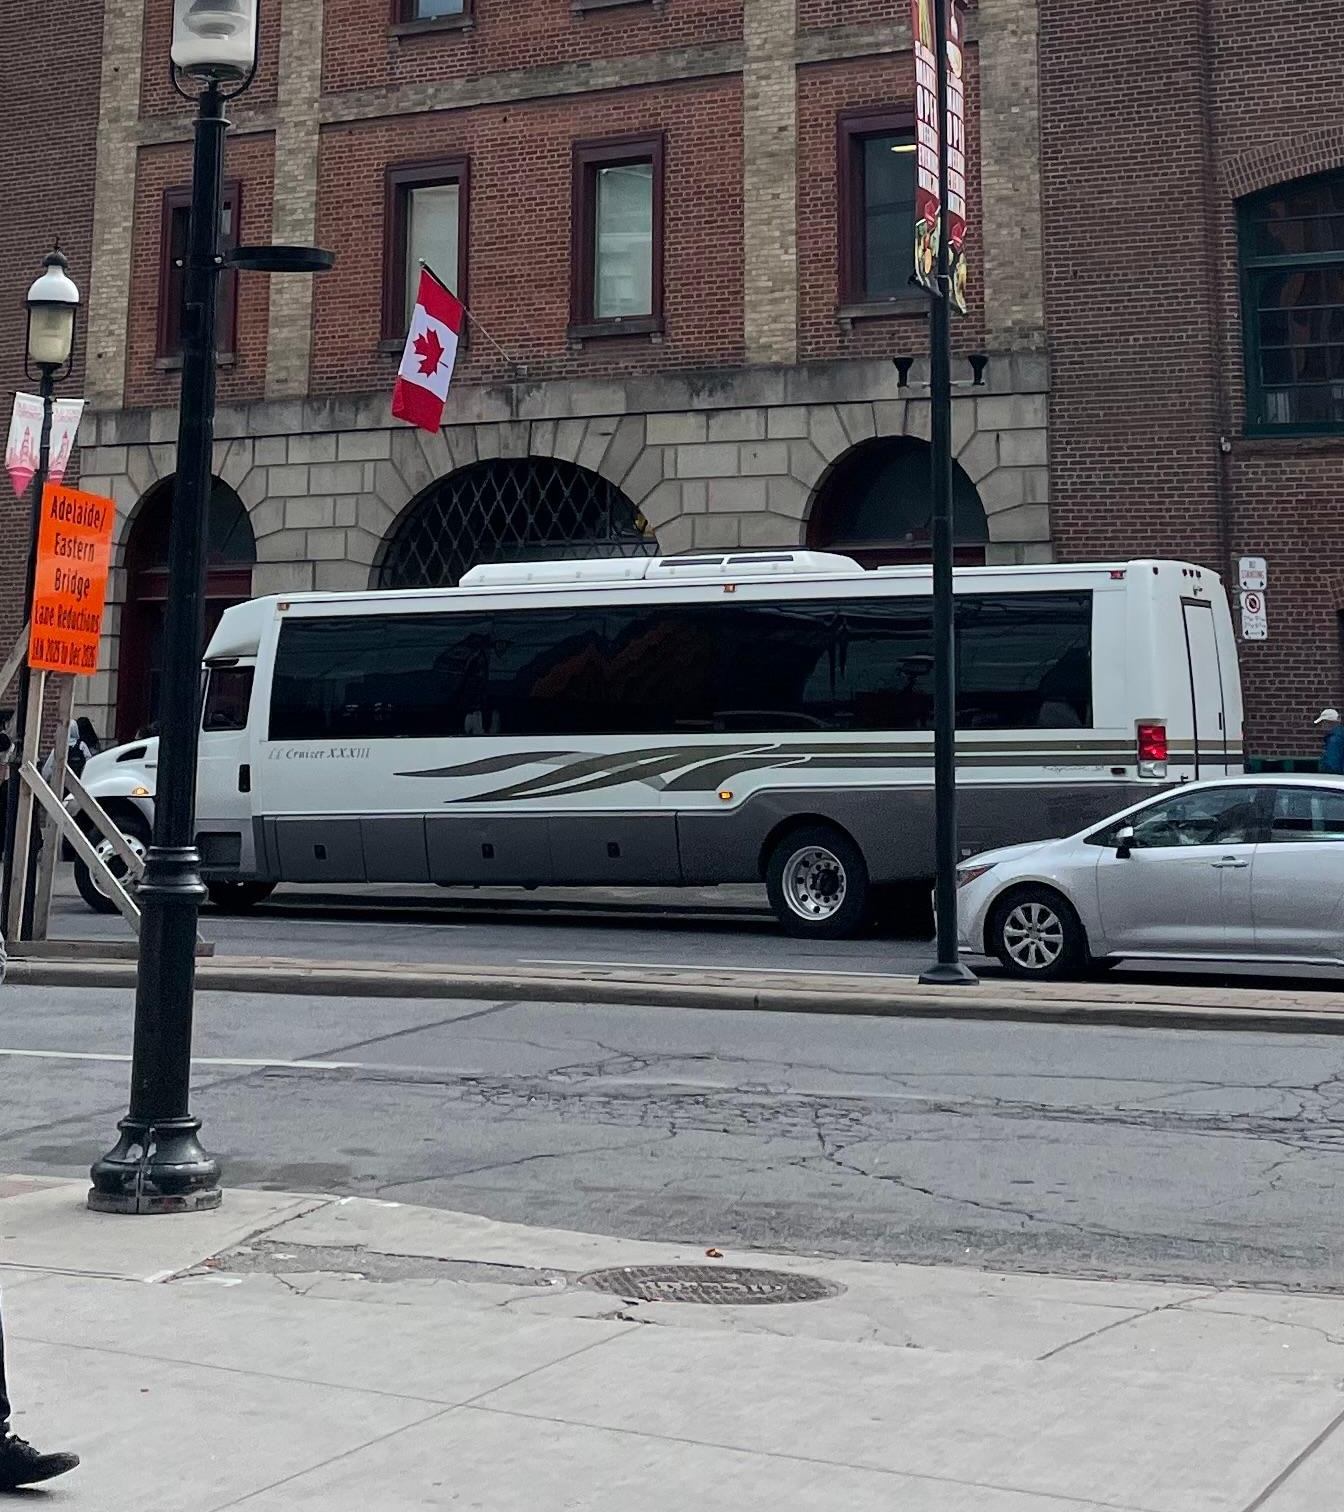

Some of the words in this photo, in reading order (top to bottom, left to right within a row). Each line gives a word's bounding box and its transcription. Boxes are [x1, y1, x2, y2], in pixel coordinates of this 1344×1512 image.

[50, 495, 106, 532] Adelaide/
[54, 532, 95, 563] Eastern
[54, 567, 90, 602] Bridge
[35, 600, 54, 626] Lane
[57, 603, 100, 634] Reductions
